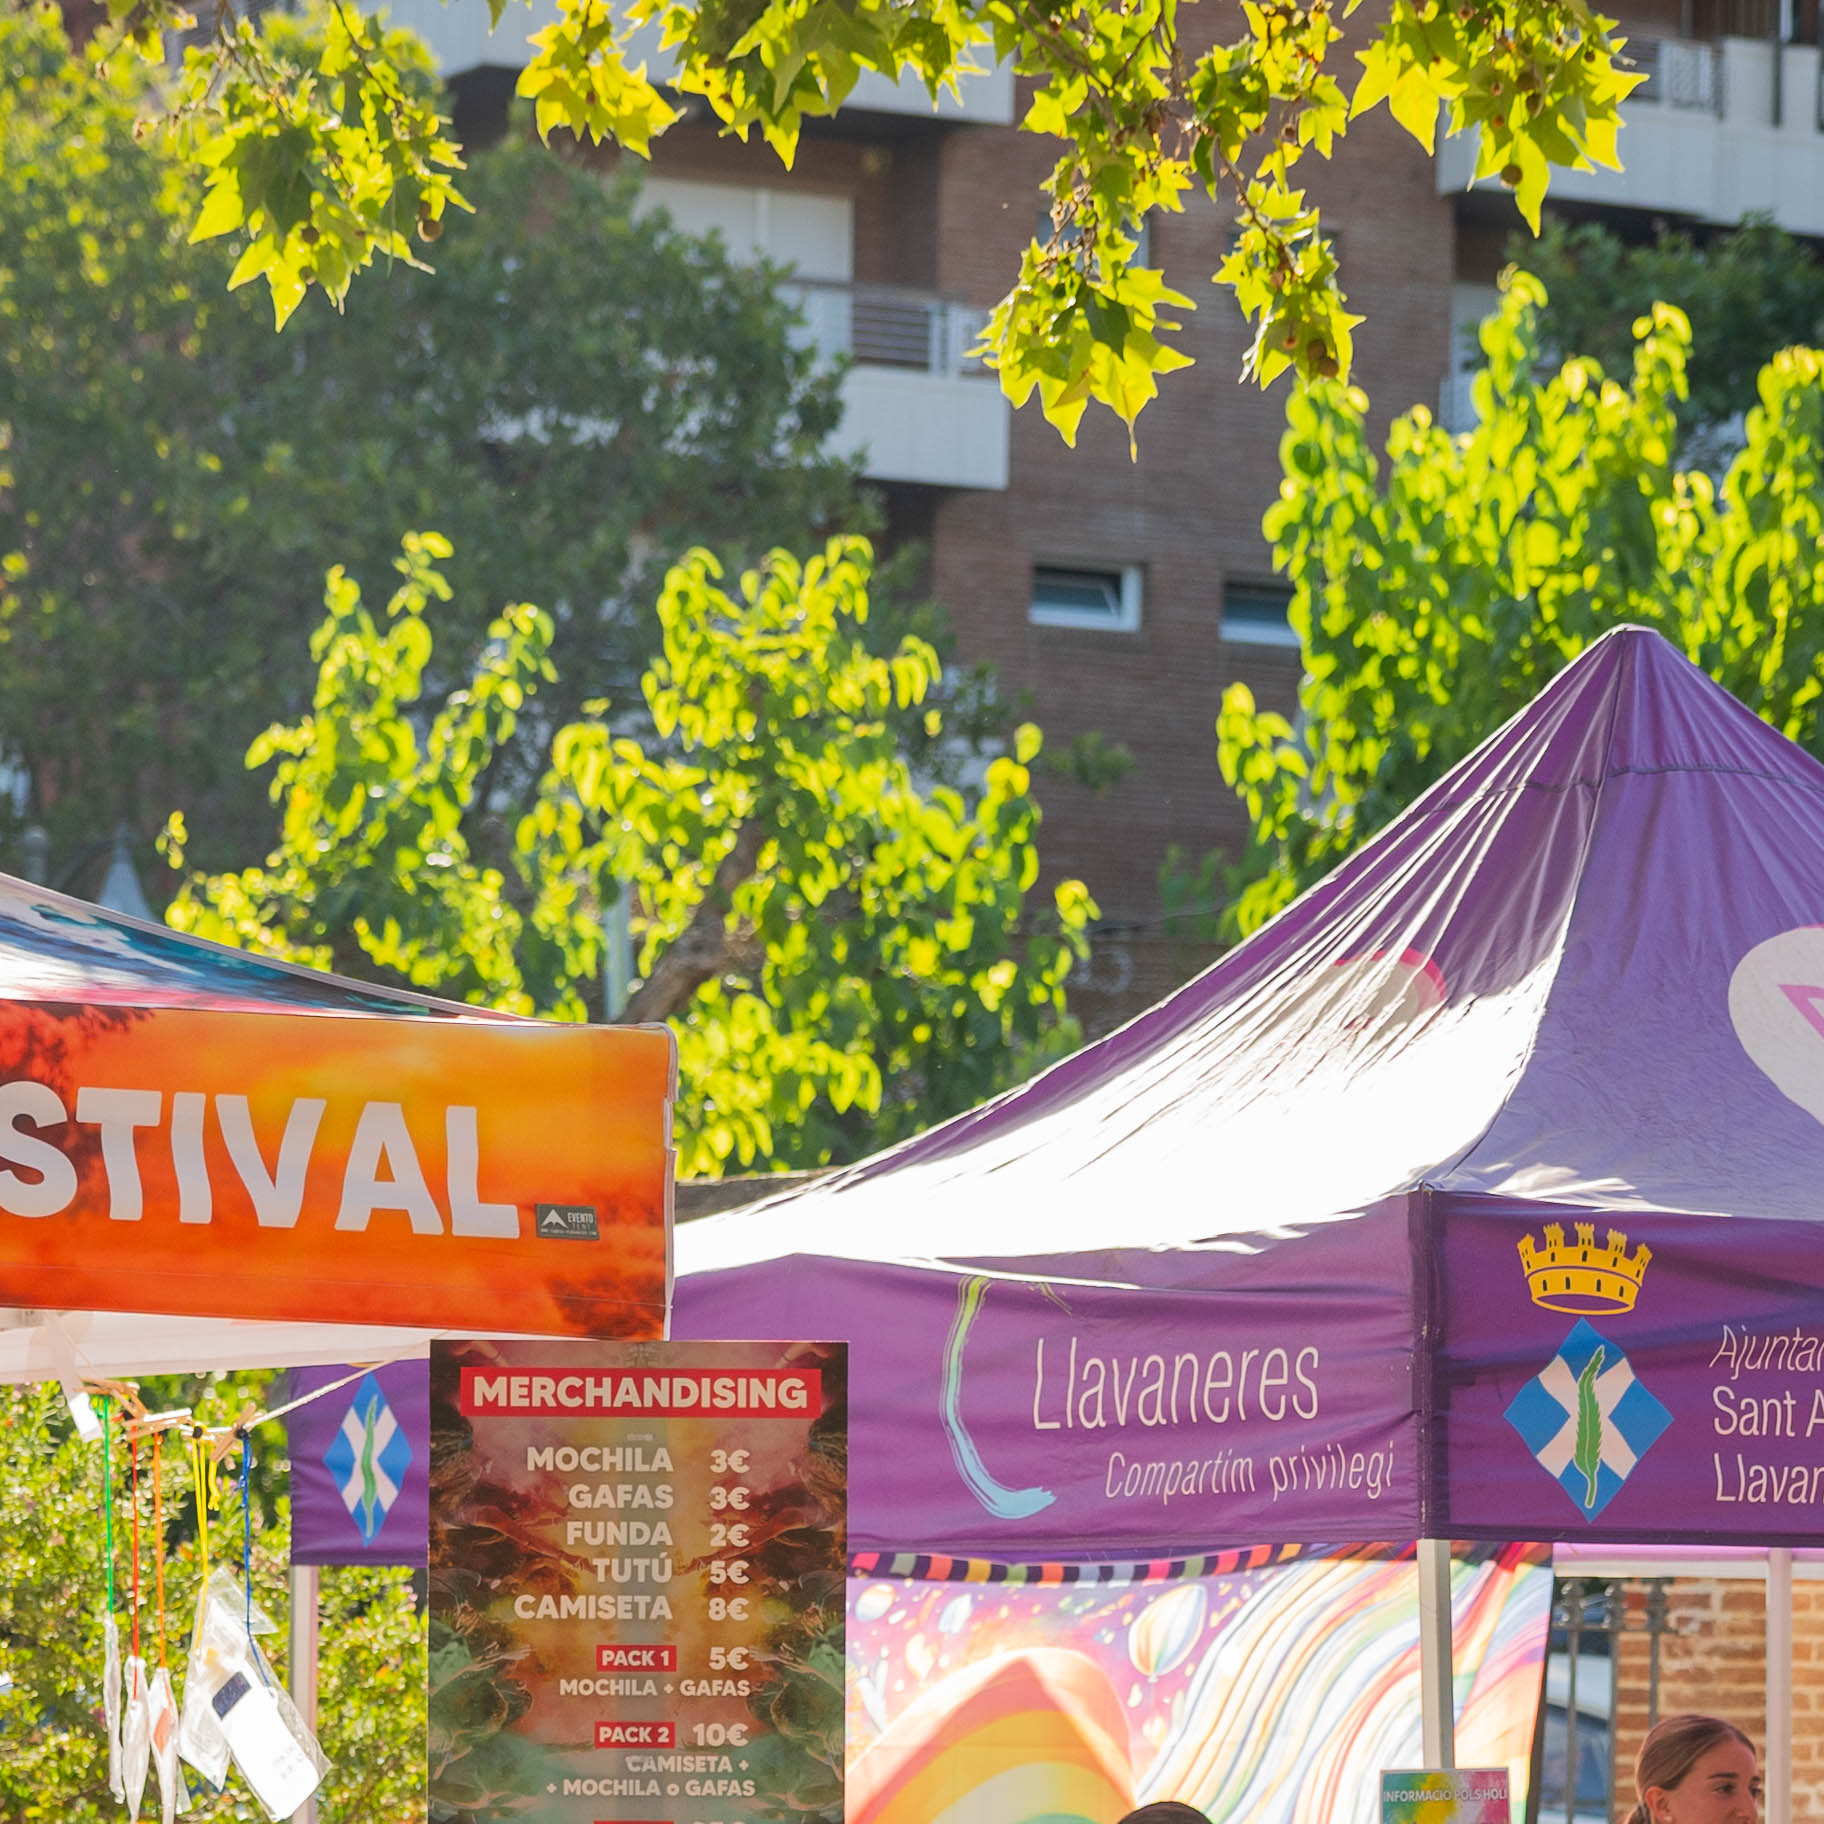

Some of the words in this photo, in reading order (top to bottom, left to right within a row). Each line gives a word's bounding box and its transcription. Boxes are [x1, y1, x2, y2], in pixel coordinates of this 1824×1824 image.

[473, 1376, 808, 1409] MERCHANDISING
[1032, 1336, 1320, 1431] Llavaneres
[1712, 1385, 1796, 1437] Sant
[526, 1446, 674, 1473] MOCHILA
[709, 1449, 751, 1474] 3€
[1106, 1446, 1254, 1505] Compartim
[1270, 1441, 1395, 1503] privilegi
[568, 1484, 674, 1510] GAFAS
[709, 1486, 751, 1511] 3€
[566, 1521, 673, 1546] FUNDA
[709, 1523, 751, 1548] 2€
[592, 1551, 673, 1583] TUTÚ
[709, 1560, 751, 1585] 5€
[513, 1594, 673, 1620] CAMISETA
[708, 1597, 749, 1622] 8€
[601, 1650, 656, 1667] PACK
[661, 1650, 670, 1667] 1
[708, 1647, 749, 1670] 5€
[559, 1679, 657, 1696] MOCHILA
[679, 1679, 751, 1697] GAFAS
[599, 1727, 653, 1743] PACK
[657, 1727, 670, 1744] 2
[692, 1723, 748, 1747] 10€
[624, 1755, 733, 1773] CAMISETA
[563, 1780, 661, 1797] MOCHILA
[684, 1780, 756, 1797] GAFAS
[1483, 1787, 1507, 1800] HOLI
